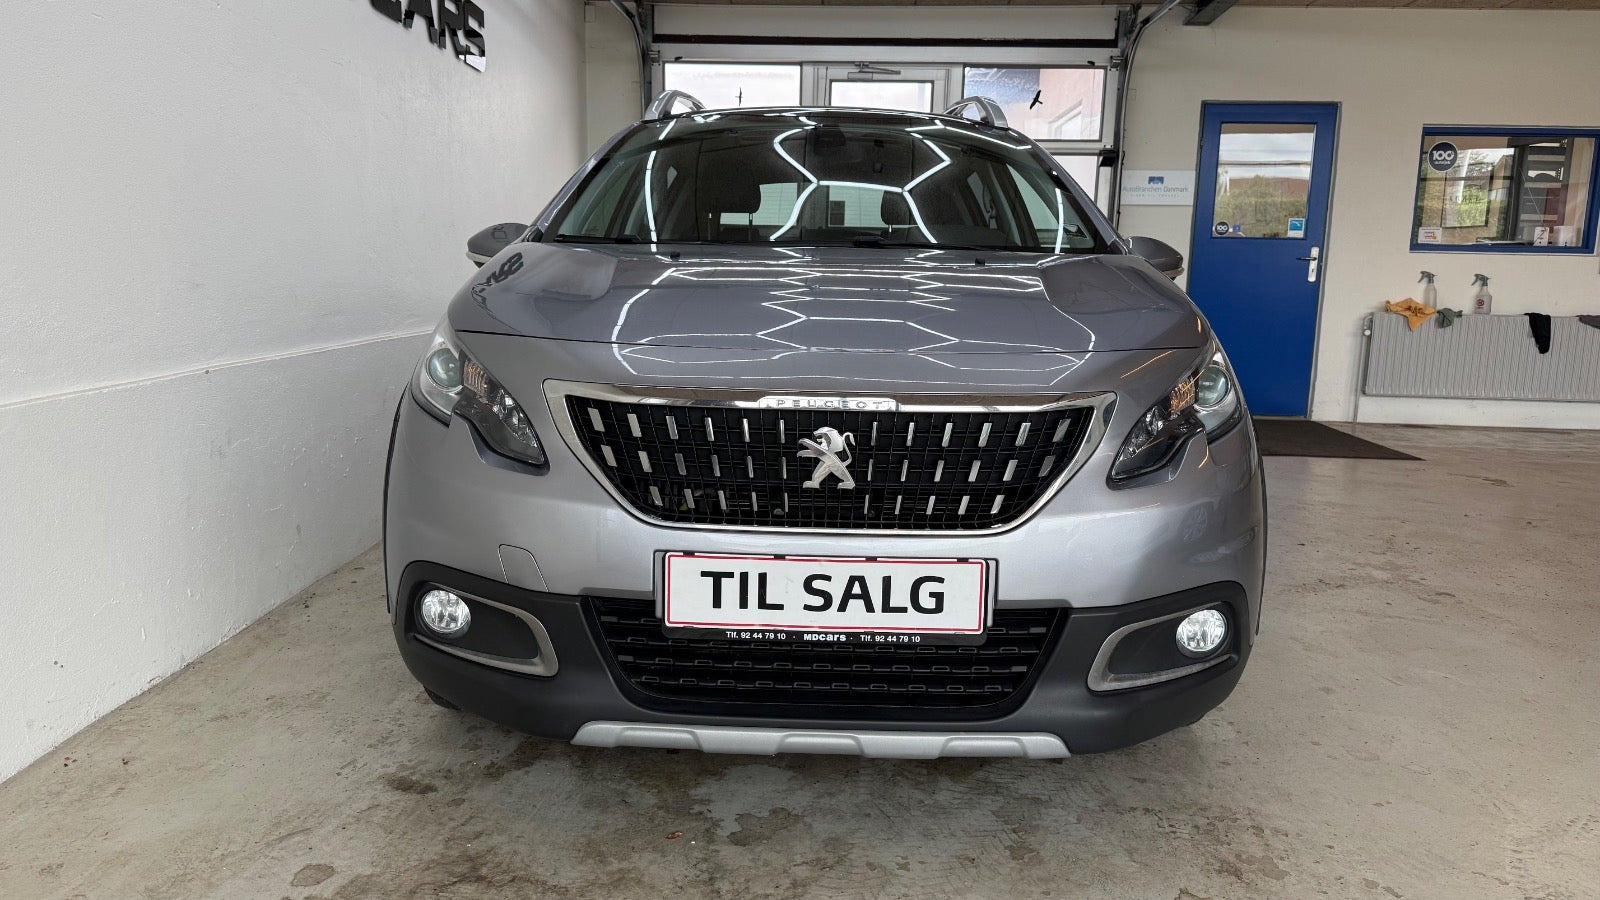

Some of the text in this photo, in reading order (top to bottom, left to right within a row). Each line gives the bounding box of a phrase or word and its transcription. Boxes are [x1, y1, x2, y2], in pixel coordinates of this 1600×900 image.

[369, 0, 486, 72] ARS
[776, 399, 883, 410] PEUGEOT
[700, 570, 945, 615] TIL SALG
[725, 631, 739, 639] Tlf.
[740, 631, 751, 639] 92
[752, 632, 763, 640] 44
[764, 632, 775, 640] 79
[776, 632, 786, 640] 10
[860, 634, 873, 642] Tlf.
[887, 635, 897, 643] 44
[899, 635, 909, 643] 79
